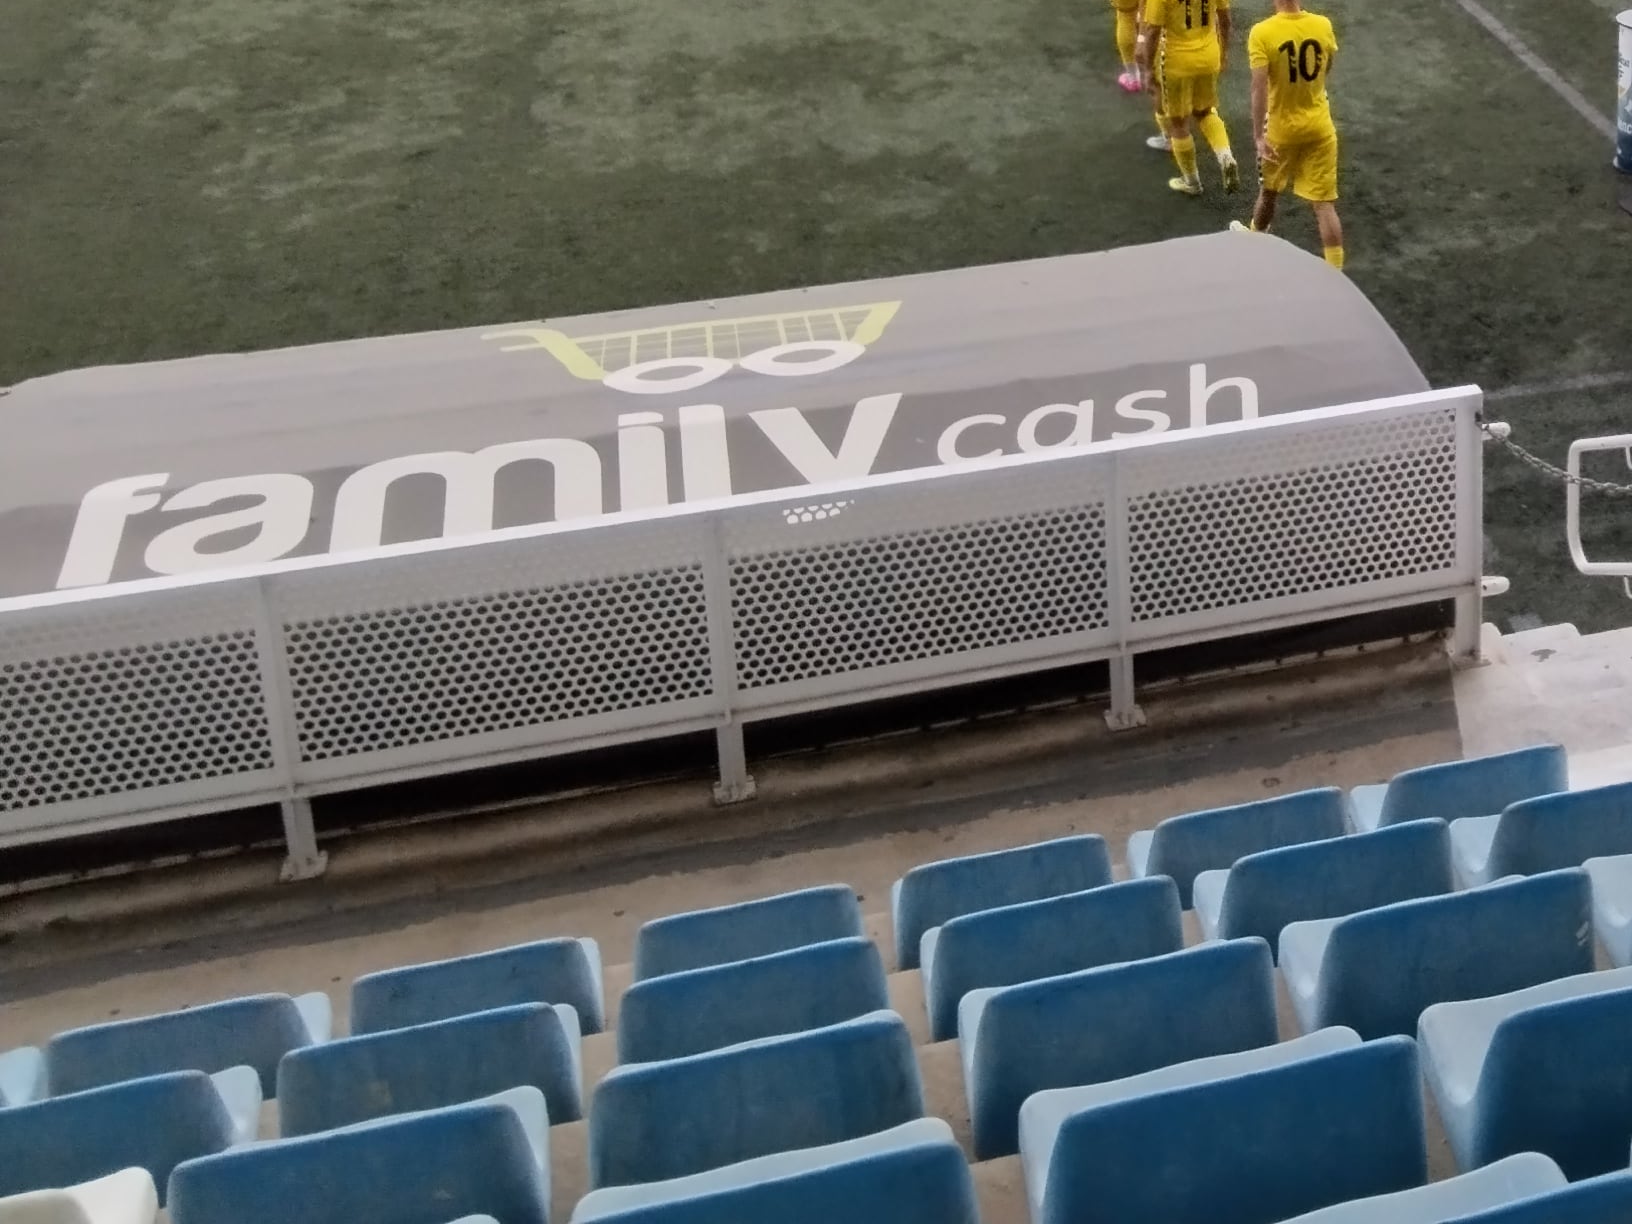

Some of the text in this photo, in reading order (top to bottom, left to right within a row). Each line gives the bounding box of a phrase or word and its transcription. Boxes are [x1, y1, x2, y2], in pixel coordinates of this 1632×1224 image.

[1277, 37, 1322, 84] 10
[56, 362, 1260, 590] family cash
